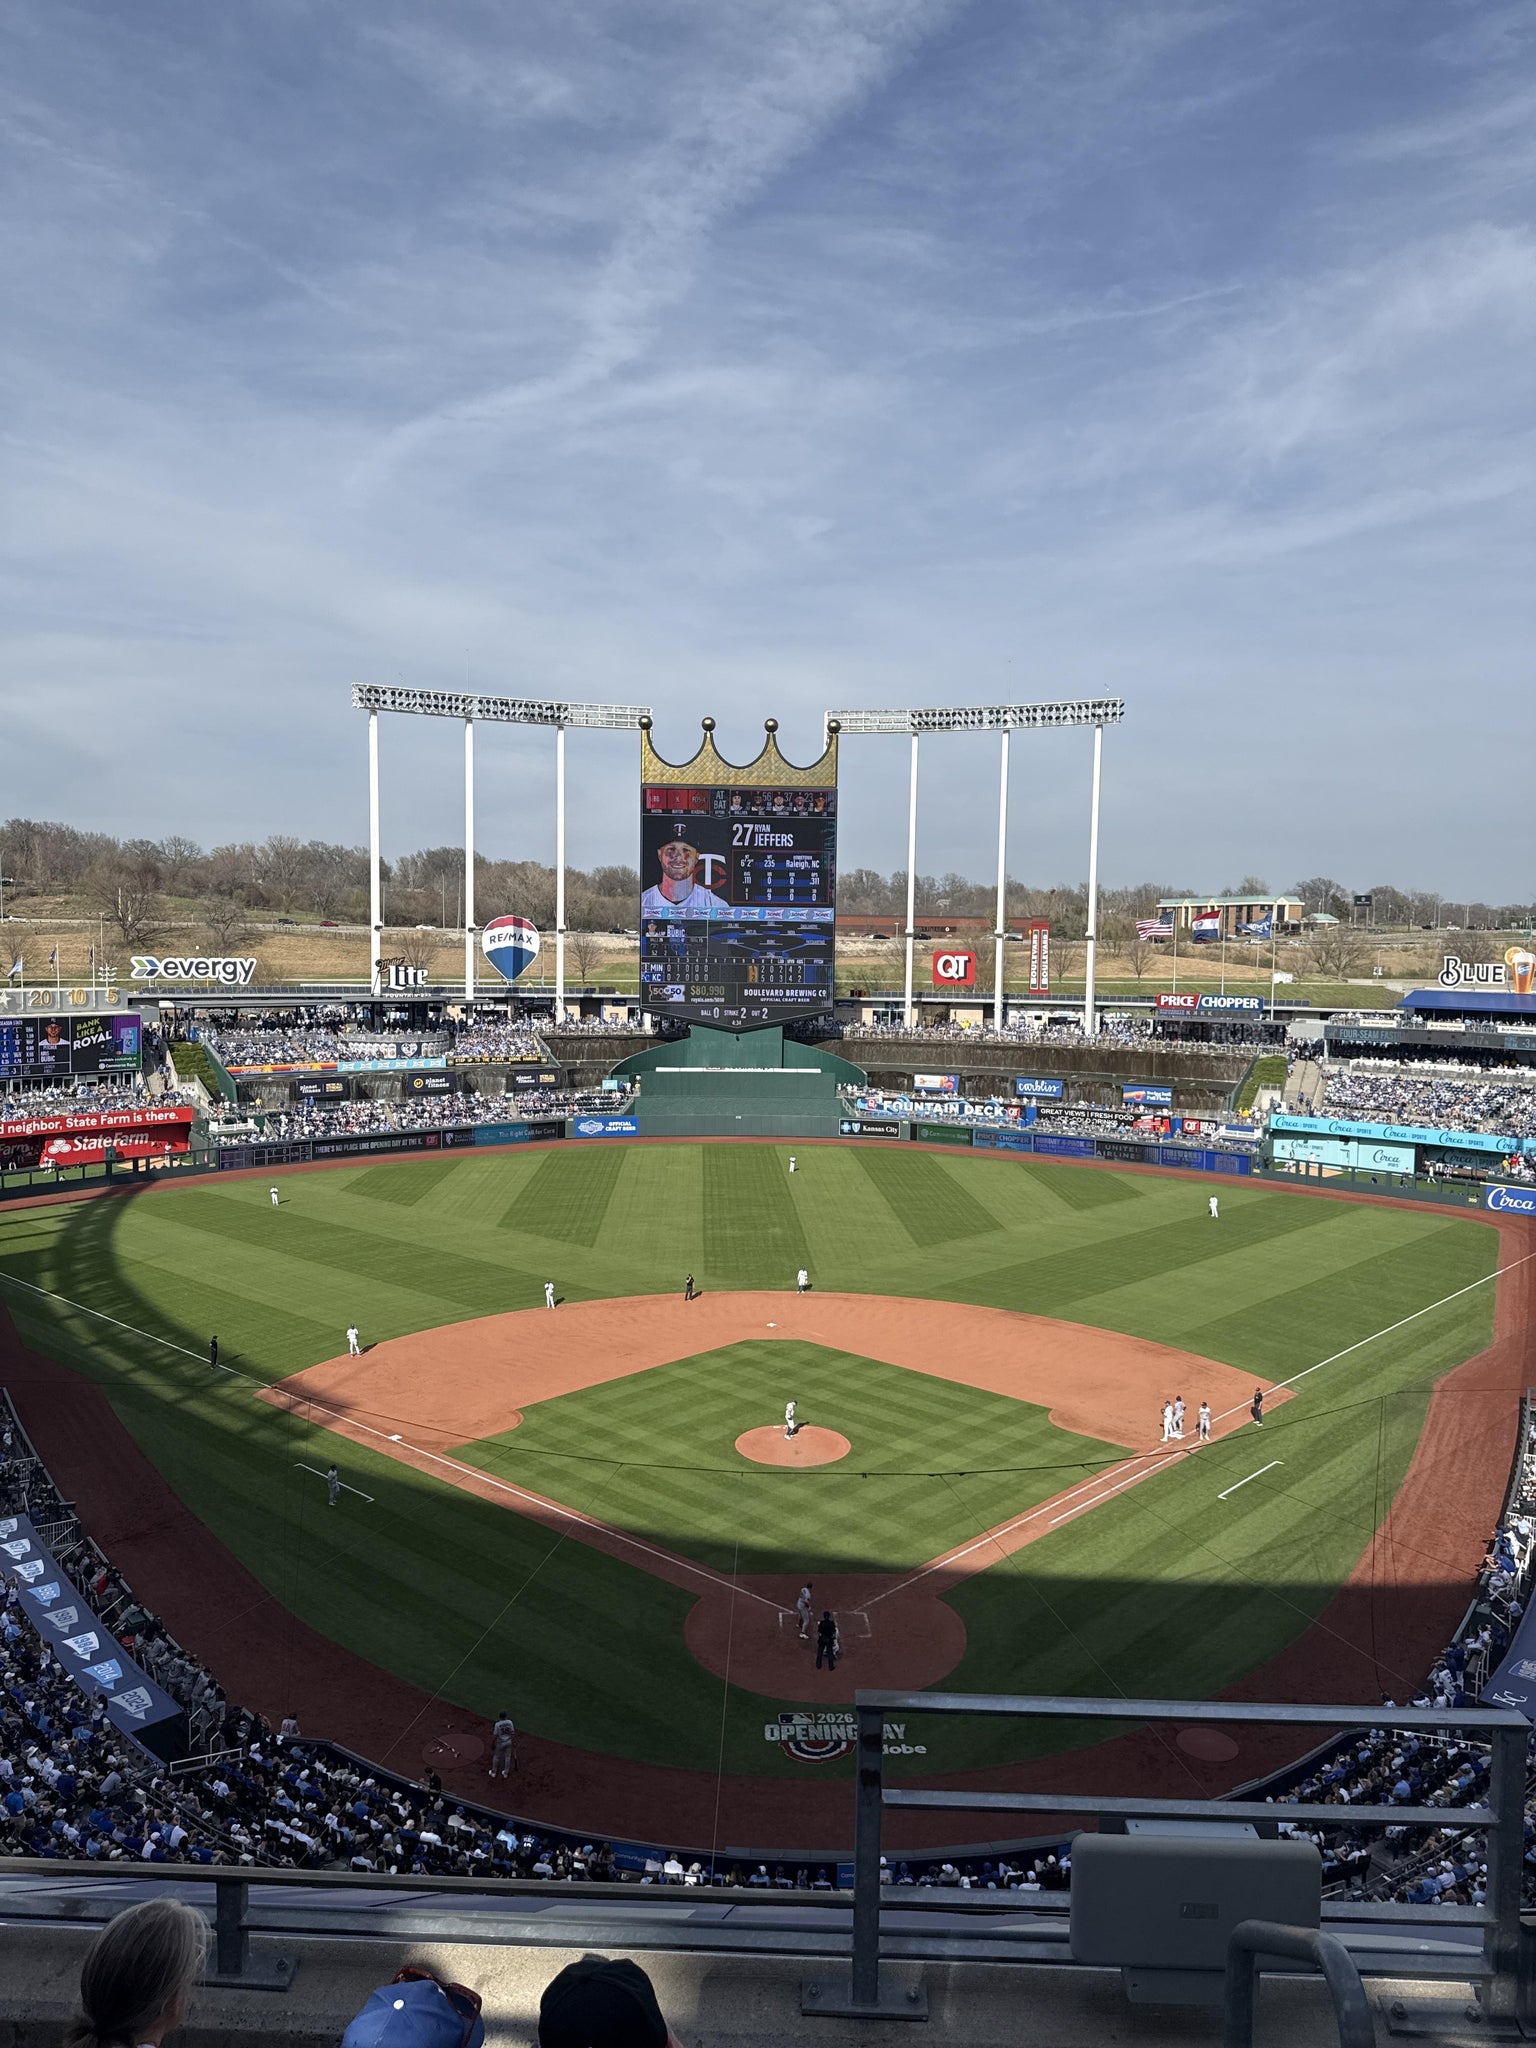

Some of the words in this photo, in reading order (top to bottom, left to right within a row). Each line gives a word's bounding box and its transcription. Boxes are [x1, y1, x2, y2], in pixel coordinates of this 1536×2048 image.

[716, 791, 725, 799] AT
[714, 800, 726, 809] BAT
[732, 824, 754, 846] 27
[754, 824, 770, 832] RYAN
[754, 834, 794, 847] JEFFERS
[786, 860, 810, 869] Raleigh,
[490, 932, 533, 945] RE/MAX
[164, 960, 254, 982] evergy
[936, 954, 969, 979] QT
[1440, 957, 1503, 986] BLUE
[386, 965, 428, 991] Lite
[30, 990, 52, 1006] 20
[67, 989, 86, 1005] 10
[106, 988, 118, 1004] 5
[691, 985, 725, 996] $80,990
[1160, 995, 1194, 1006] PRICE
[1201, 997, 1259, 1008] CHOPPER
[714, 1007, 719, 1018] 0
[740, 1008, 746, 1018] 2
[762, 1008, 768, 1019] 2
[76, 1018, 100, 1030] BANK
[76, 1028, 94, 1038] LIKE
[73, 1030, 112, 1050] ROYAL
[426, 1078, 445, 1086] planet
[1018, 1080, 1059, 1091] carbliss
[883, 1100, 959, 1115] FOUNTAIN
[964, 1106, 1006, 1116] DECK
[8, 1120, 62, 1134] neighbor,
[66, 1117, 98, 1128] State
[101, 1115, 130, 1125] Farm
[133, 1113, 142, 1122] is
[145, 1112, 178, 1121] there.
[1185, 1122, 1197, 1130] QT
[886, 1126, 898, 1135] City
[1275, 1116, 1299, 1128] Circa
[1329, 1121, 1352, 1133] Circa
[1383, 1126, 1407, 1138] Circa
[1439, 1132, 1464, 1144] Circa
[999, 1135, 1030, 1143] CHOPPER
[315, 1145, 334, 1154] THERE'S
[370, 1141, 391, 1149] OPENING
[1373, 1149, 1400, 1163] Circa
[1488, 1188, 1536, 1210] Circa
[72, 1635, 96, 1652] 1984
[93, 1663, 118, 1680] 2014
[121, 1691, 149, 1710] 2024
[817, 1713, 854, 1723] 2026
[764, 1724, 858, 1740] OPENING
[882, 1724, 906, 1740] AY
